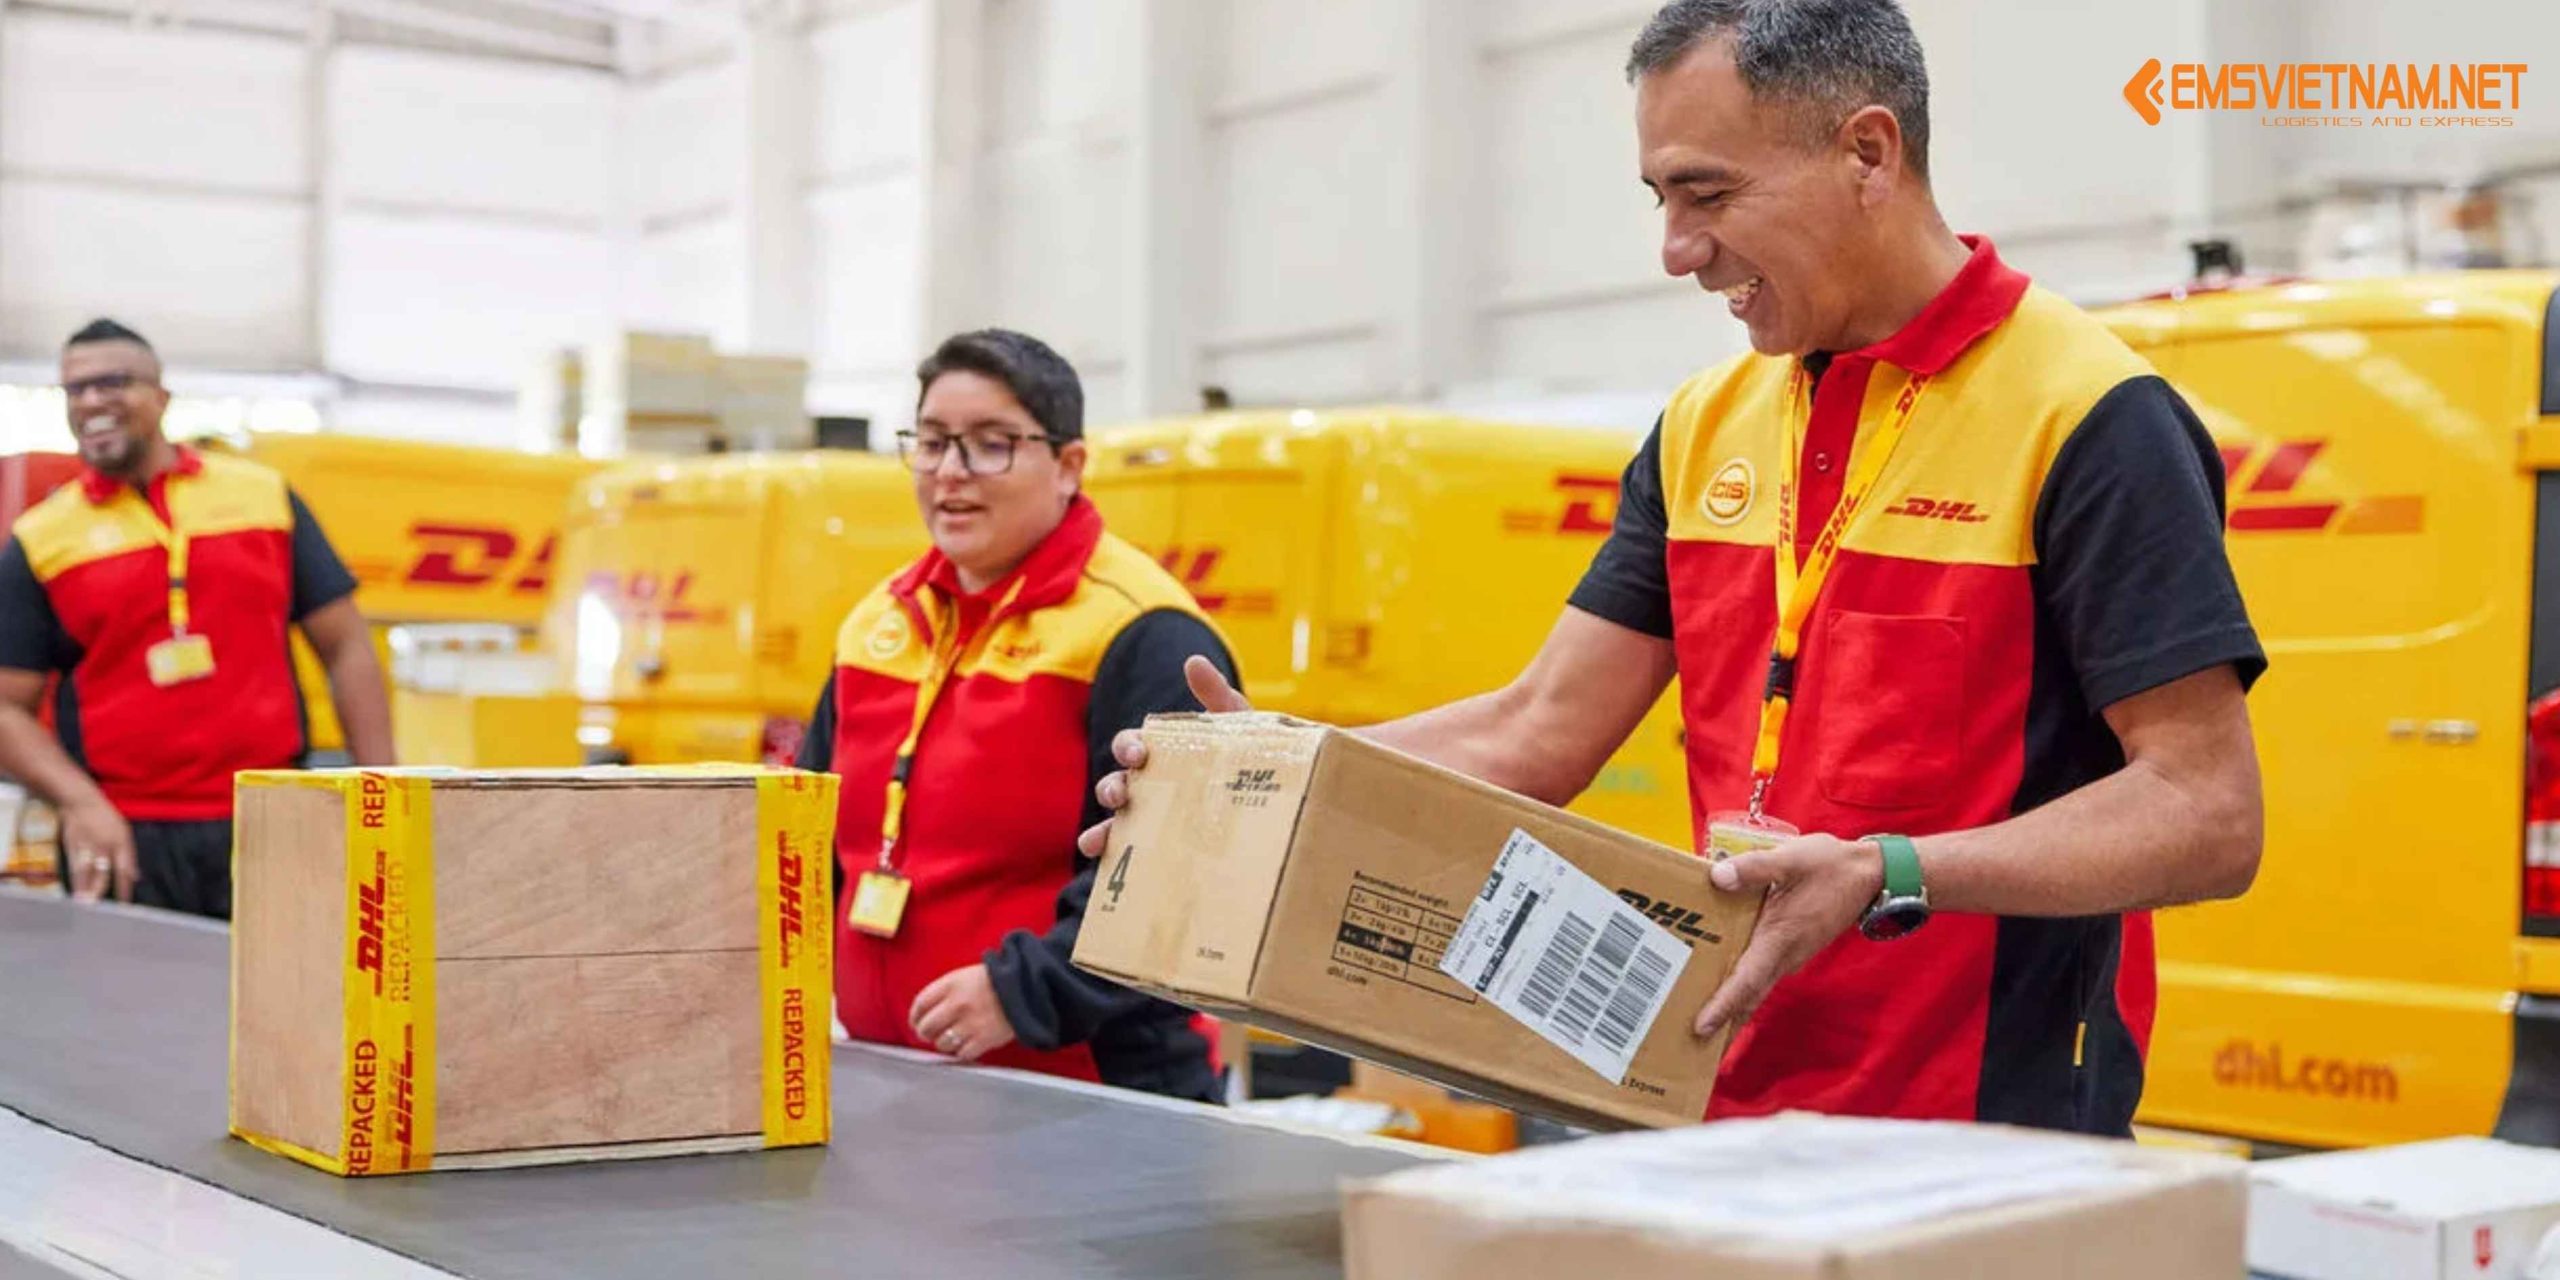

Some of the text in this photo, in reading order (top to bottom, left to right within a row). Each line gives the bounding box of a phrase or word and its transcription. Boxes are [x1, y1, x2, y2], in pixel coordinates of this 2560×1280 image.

[1710, 482, 1746, 500] CIS
[1900, 497, 1981, 522] DHL
[1816, 493, 1864, 560] DHL
[776, 854, 802, 944] DHL
[1107, 844, 1133, 903] 4
[357, 874, 385, 980] DHL
[784, 988, 806, 1120] REPACKED
[2213, 1040, 2399, 1103] dhl.com
